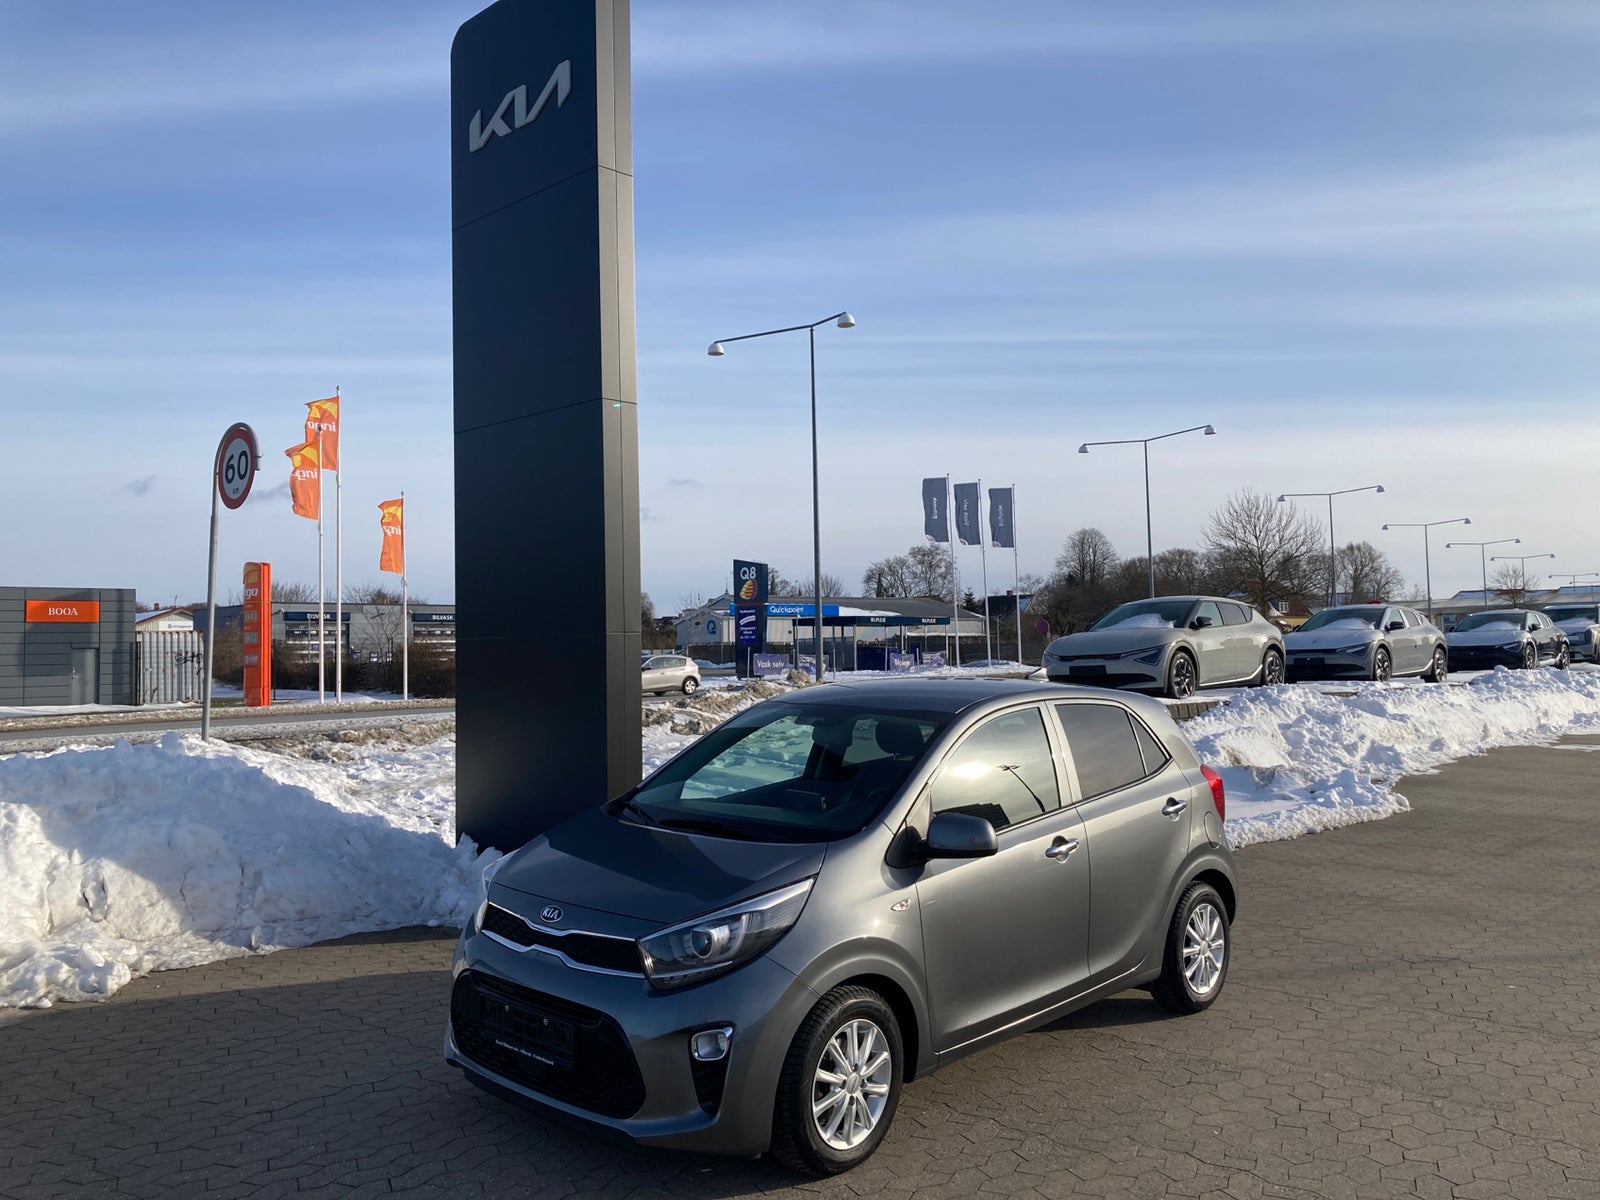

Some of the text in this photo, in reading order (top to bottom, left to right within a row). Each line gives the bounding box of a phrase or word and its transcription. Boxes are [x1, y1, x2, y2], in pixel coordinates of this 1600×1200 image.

[469, 59, 571, 152] KIA
[225, 450, 249, 484] 60
[740, 566, 757, 580] Q8
[48, 607, 78, 616] BOOA
[769, 605, 804, 614] Quickpoint
[756, 659, 785, 668] Vask selv
[542, 907, 559, 920] KIA
